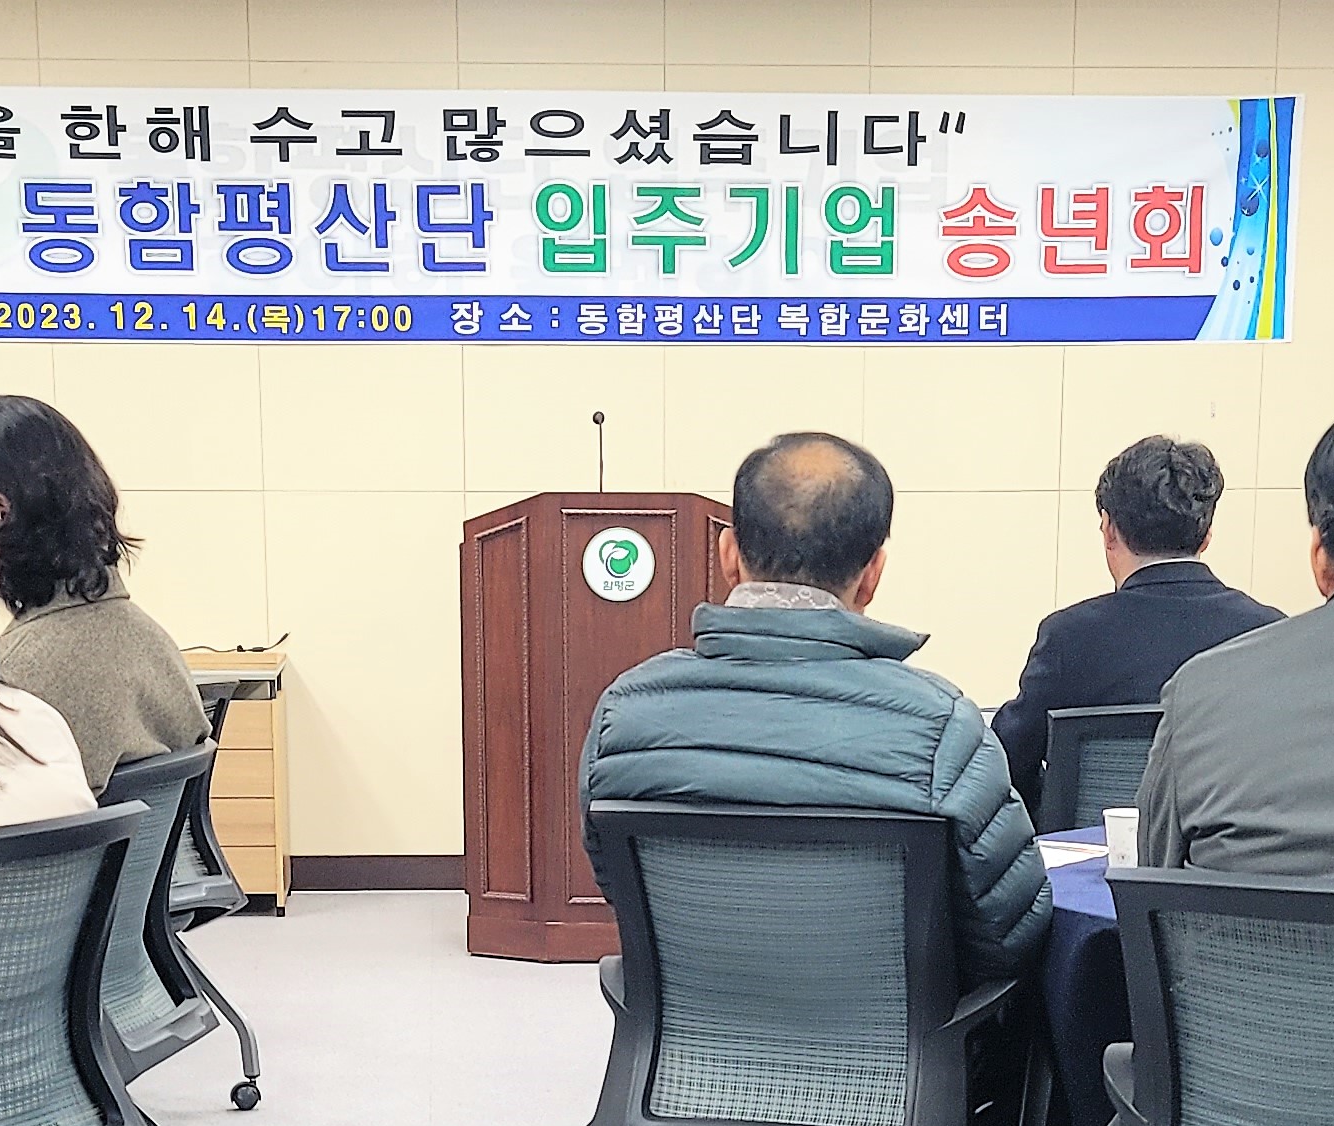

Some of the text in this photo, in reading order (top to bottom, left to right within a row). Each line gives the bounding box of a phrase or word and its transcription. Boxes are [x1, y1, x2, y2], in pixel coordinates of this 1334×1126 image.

[59, 104, 212, 163] 한해
[249, 105, 404, 164] 수고
[21, 180, 495, 276] 동함평산단
[534, 182, 896, 276] 입주기업
[942, 184, 1205, 277] 송년회
[576, 303, 762, 336] 동함평산단
[777, 303, 1009, 336] 복합문화센터
